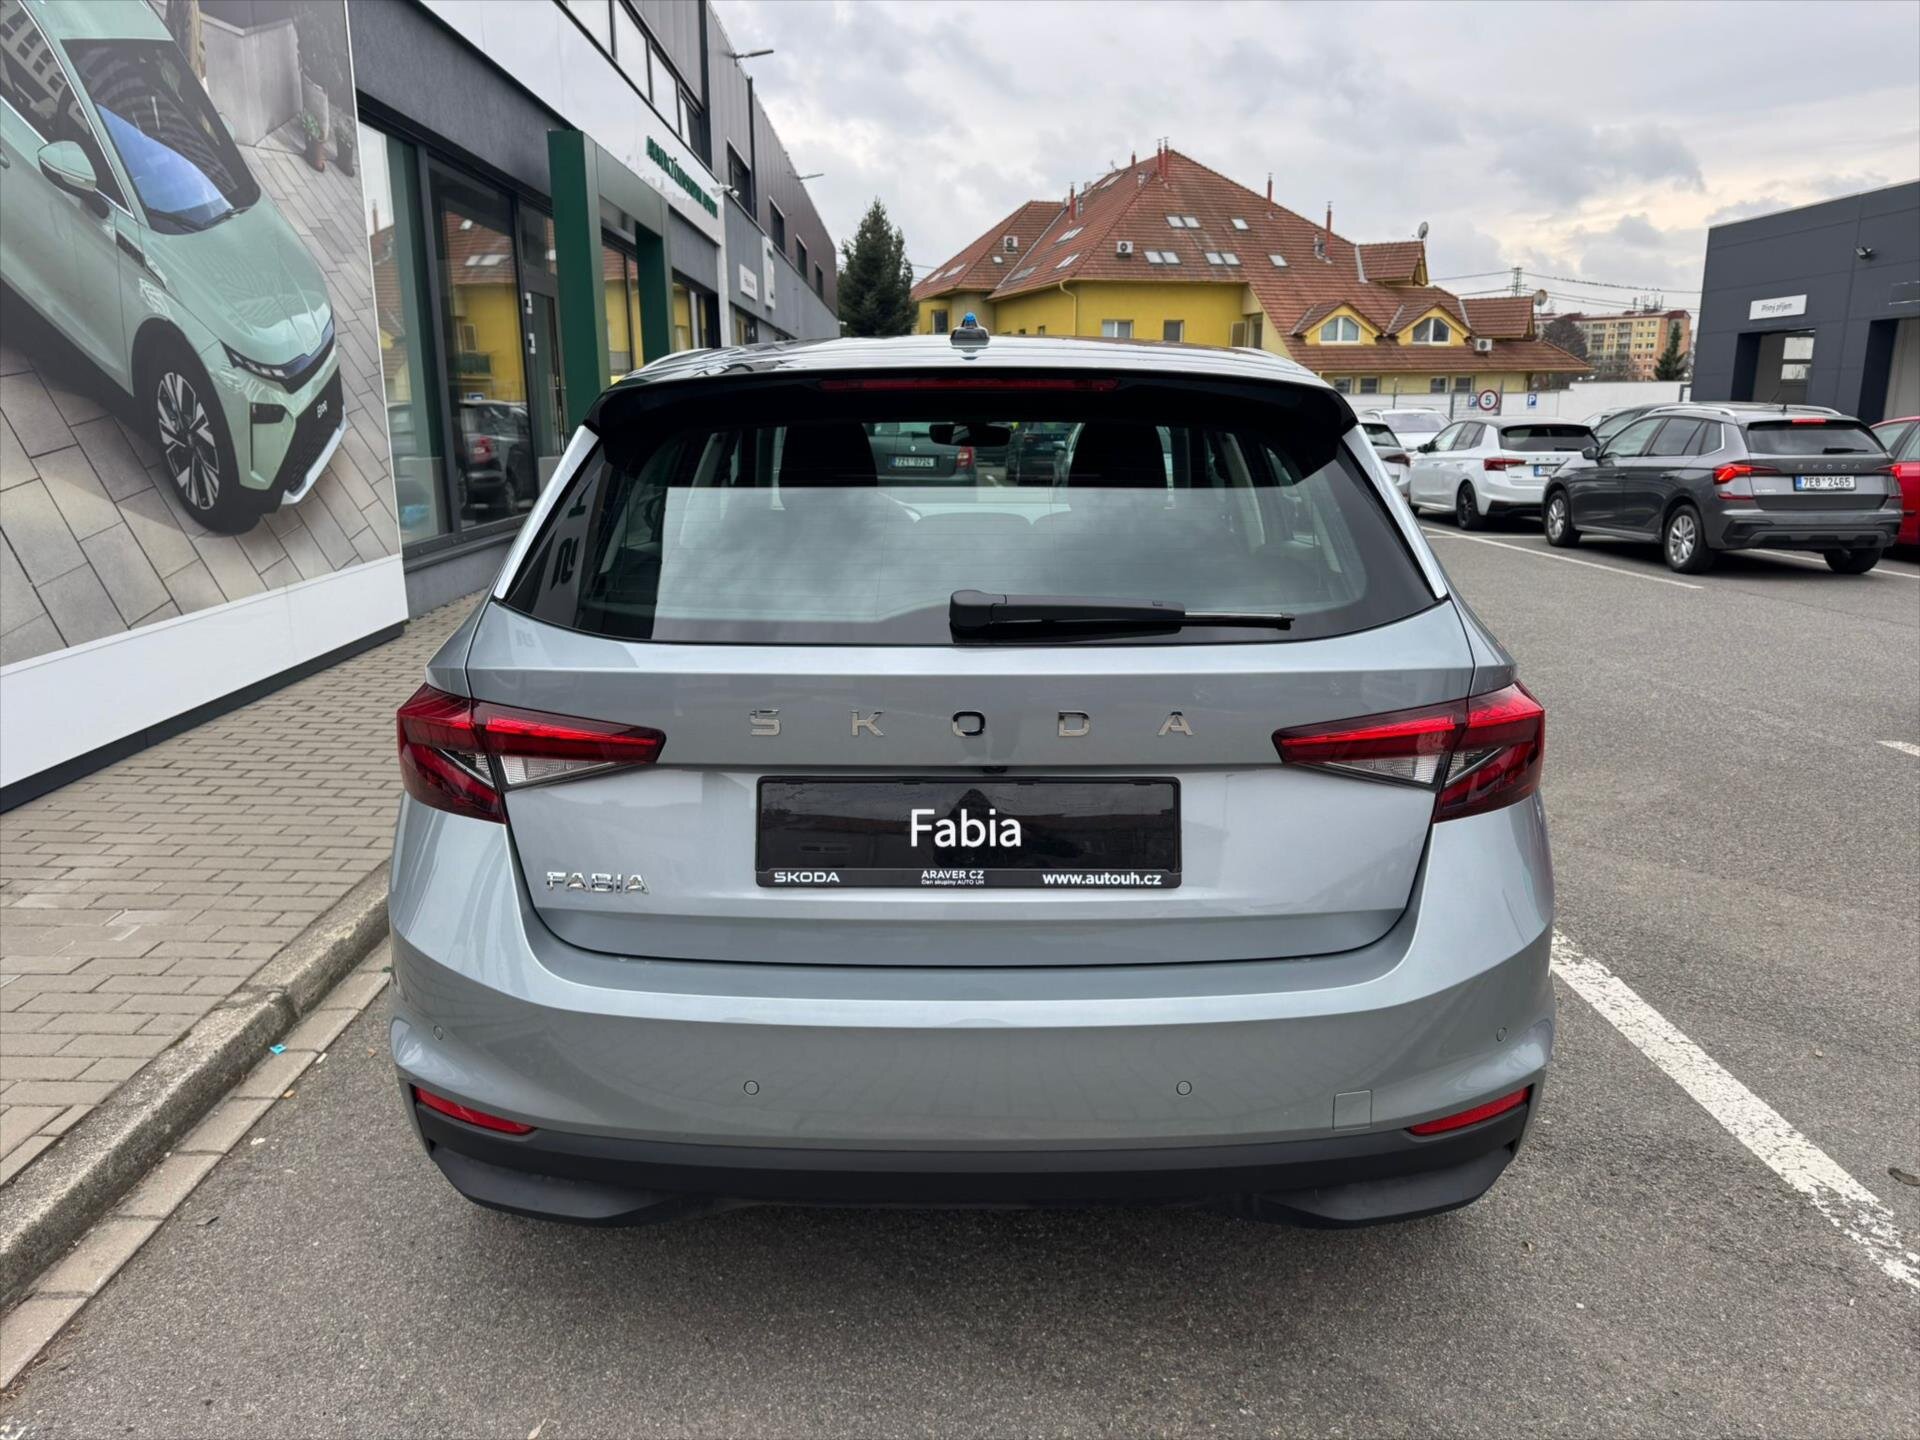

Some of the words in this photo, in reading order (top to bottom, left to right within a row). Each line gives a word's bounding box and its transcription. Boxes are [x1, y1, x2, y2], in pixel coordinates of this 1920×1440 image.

[1485, 395, 1492, 405] 5
[1529, 394, 1536, 404] P
[1804, 476, 1821, 487] 7E8
[1828, 477, 1851, 487] 2465
[911, 809, 1021, 847] Fabia
[921, 870, 967, 879] ARAVER
[969, 870, 985, 879] CZ
[1042, 872, 1162, 885] www.autouh.cz
[546, 872, 649, 895] FABIA
